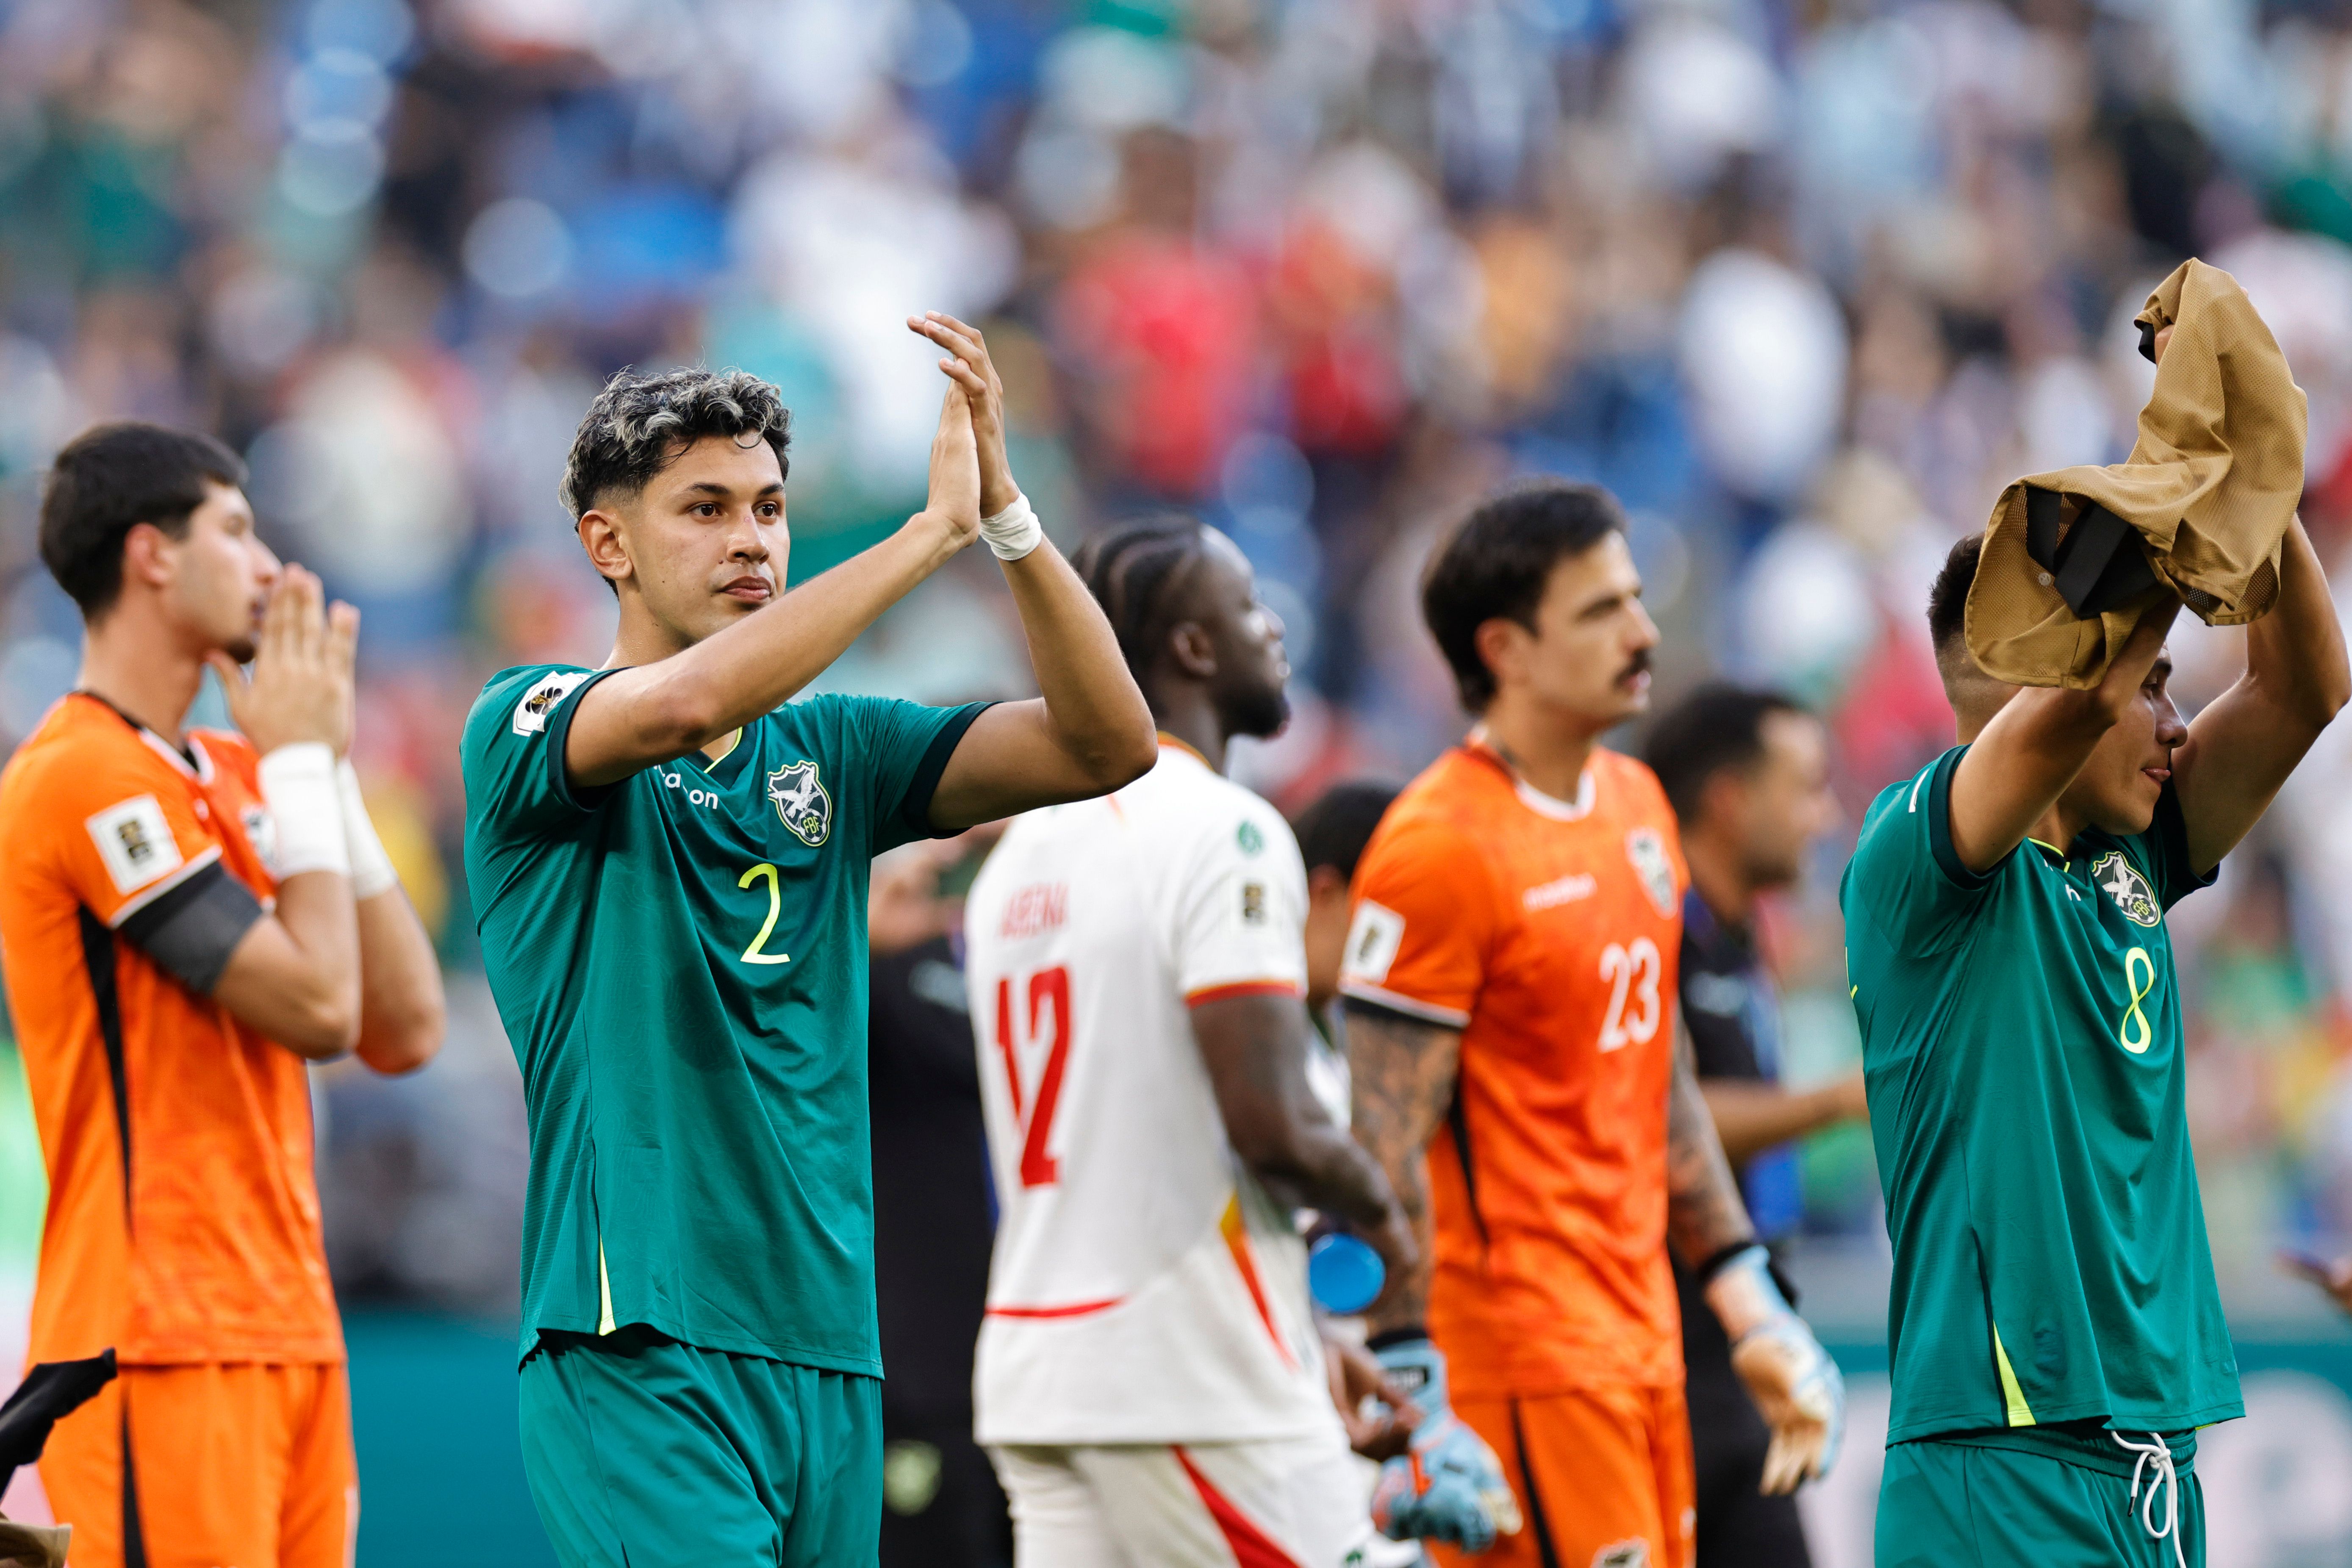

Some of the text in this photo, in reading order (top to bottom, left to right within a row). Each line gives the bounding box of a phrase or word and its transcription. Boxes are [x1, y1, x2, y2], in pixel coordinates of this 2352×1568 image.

[803, 816, 819, 834] FBF
[738, 863, 790, 964] 2
[2133, 900, 2150, 916] FBF
[1598, 937, 1661, 1053] 23
[2120, 947, 2154, 1053] 8
[996, 964, 1071, 1188] 12
